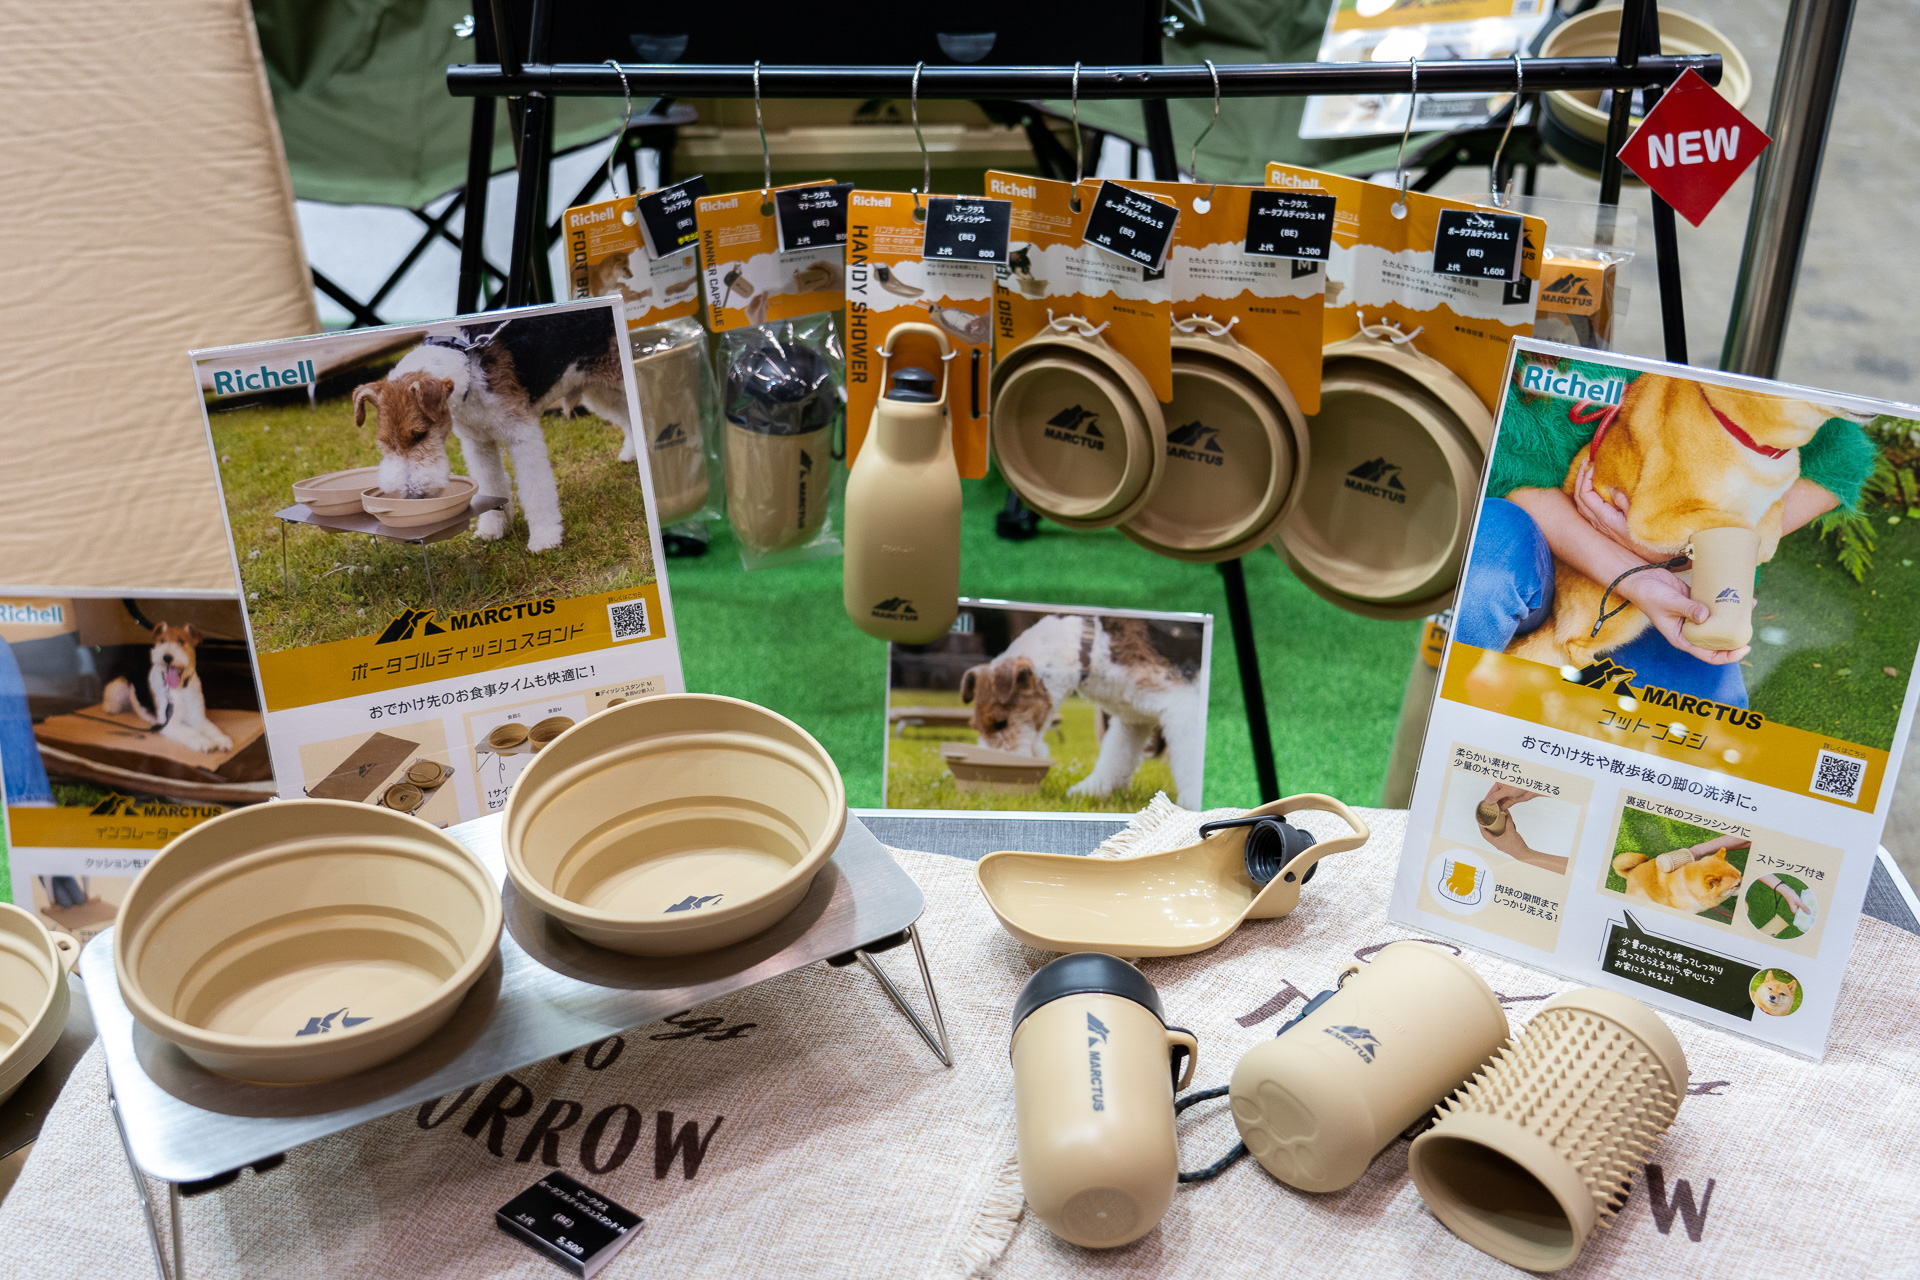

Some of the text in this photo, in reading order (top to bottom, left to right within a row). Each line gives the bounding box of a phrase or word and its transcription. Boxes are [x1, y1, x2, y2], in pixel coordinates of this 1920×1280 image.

[1647, 125, 1740, 169] NEW
[990, 179, 1037, 199] Richell
[1271, 171, 1319, 188] Richell
[700, 198, 738, 212] Richell
[798, 201, 838, 210] マナーカプセル
[801, 192, 831, 200] マークタス
[852, 195, 891, 208] Richell
[1124, 196, 1152, 213] マークタス
[1277, 199, 1309, 209] マークタス
[570, 207, 615, 227] Richell
[945, 215, 992, 223] ハンディシャワー
[955, 205, 985, 214] マークタス
[1105, 200, 1157, 226] ポータブルディッシュ
[1258, 208, 1315, 220] ポータブルディッシュ
[1317, 213, 1326, 221] M
[812, 219, 830, 228] (BE)
[1119, 225, 1136, 238] (BE)
[1280, 229, 1298, 238] (BE)
[796, 237, 811, 245] 上代
[958, 233, 976, 242] (BE)
[1447, 228, 1503, 240] ポータブルディッシュ
[573, 230, 588, 271] FOOT
[936, 247, 995, 258] 上代 800
[1096, 234, 1151, 262] 上代 1,000
[1258, 243, 1321, 256] 上代 1,300
[1466, 249, 1484, 259] (BE)
[703, 230, 725, 327] MANNER CAPSULE
[1446, 263, 1505, 277] 上代 1,600
[1512, 284, 1522, 299] L
[1541, 293, 1592, 306] MARCTUS
[851, 225, 869, 383] HANDY SHOWER
[998, 300, 1015, 338] DISH
[213, 359, 316, 396] Richell
[1522, 365, 1624, 405] Richell
[1044, 427, 1104, 451] MARCTUS
[1344, 479, 1406, 504] MARCTUS
[608, 592, 643, 602] 詳しくはこちら
[450, 599, 556, 631] MARCTUS
[871, 611, 919, 621] MARCTUS
[351, 623, 584, 681] ポータブルディッシュスタンド
[369, 665, 596, 719] おでかけ先のお食事タイムも快適に！
[1642, 687, 1764, 730] MARCTUS
[1455, 747, 1522, 773] 柔らかい素材で、
[1823, 741, 1867, 759] 詳しくはこちら
[1453, 758, 1560, 796] 少量の水でしっかり洗える
[1521, 735, 1760, 813] おでかけ先や散歩後の脚の洗浄に。
[488, 786, 513, 798] 1サイ
[144, 806, 222, 818] MARCTUS
[1626, 795, 1751, 838] 裏返して体のブラッシングに
[96, 826, 192, 840] インフレーター
[1756, 853, 1826, 881] ストラップ付き
[1494, 884, 1559, 911] 肉球の隙間まで
[1621, 937, 1724, 975] 少量の水でも握ってしっかり
[1617, 948, 1715, 985] 洗ってもらえるから、安心して
[1322, 1028, 1373, 1064] MARCTUS
[1089, 1050, 1105, 1112] MARCTUS
[538, 1180, 619, 1228] ポータブルディッシュスタンド
[577, 1190, 609, 1211] マークタス
[552, 1213, 575, 1228] (BE)
[515, 1213, 585, 1255] 上代 5,500
